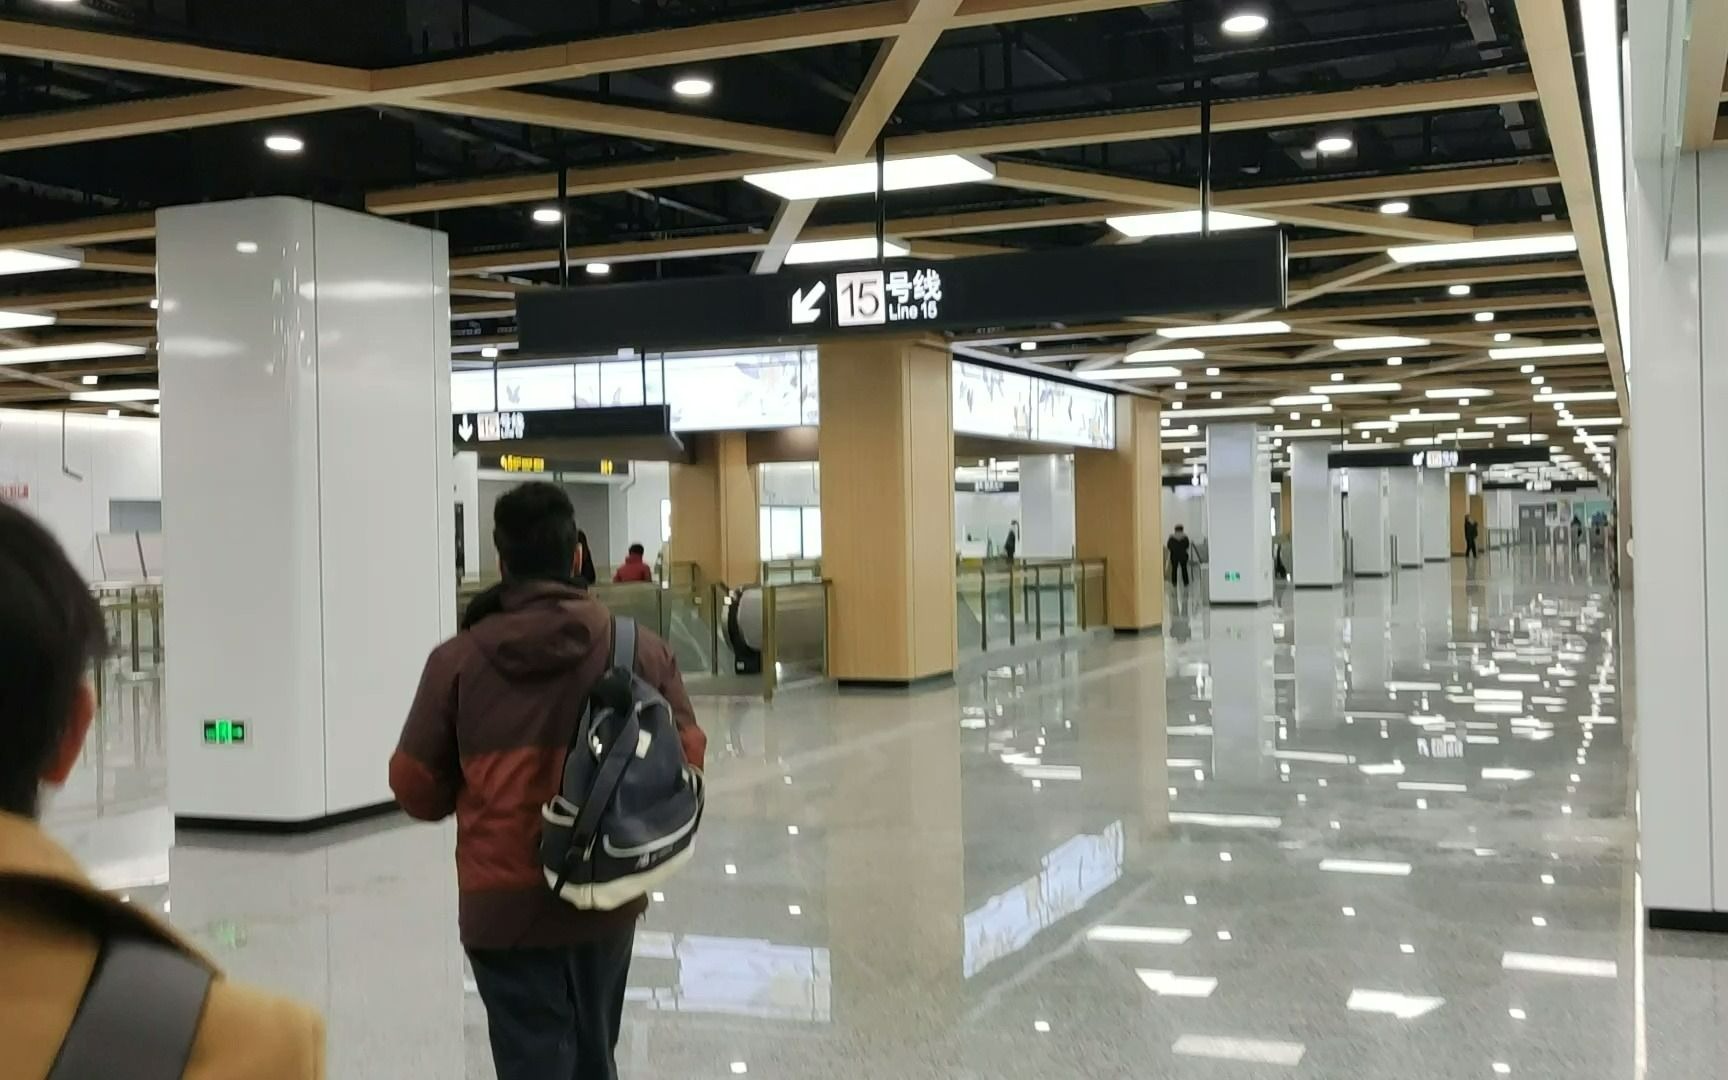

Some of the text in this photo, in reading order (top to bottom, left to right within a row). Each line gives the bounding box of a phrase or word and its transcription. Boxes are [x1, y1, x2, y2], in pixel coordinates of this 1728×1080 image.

[841, 269, 942, 318] 15 号线
[888, 303, 918, 321] Line
